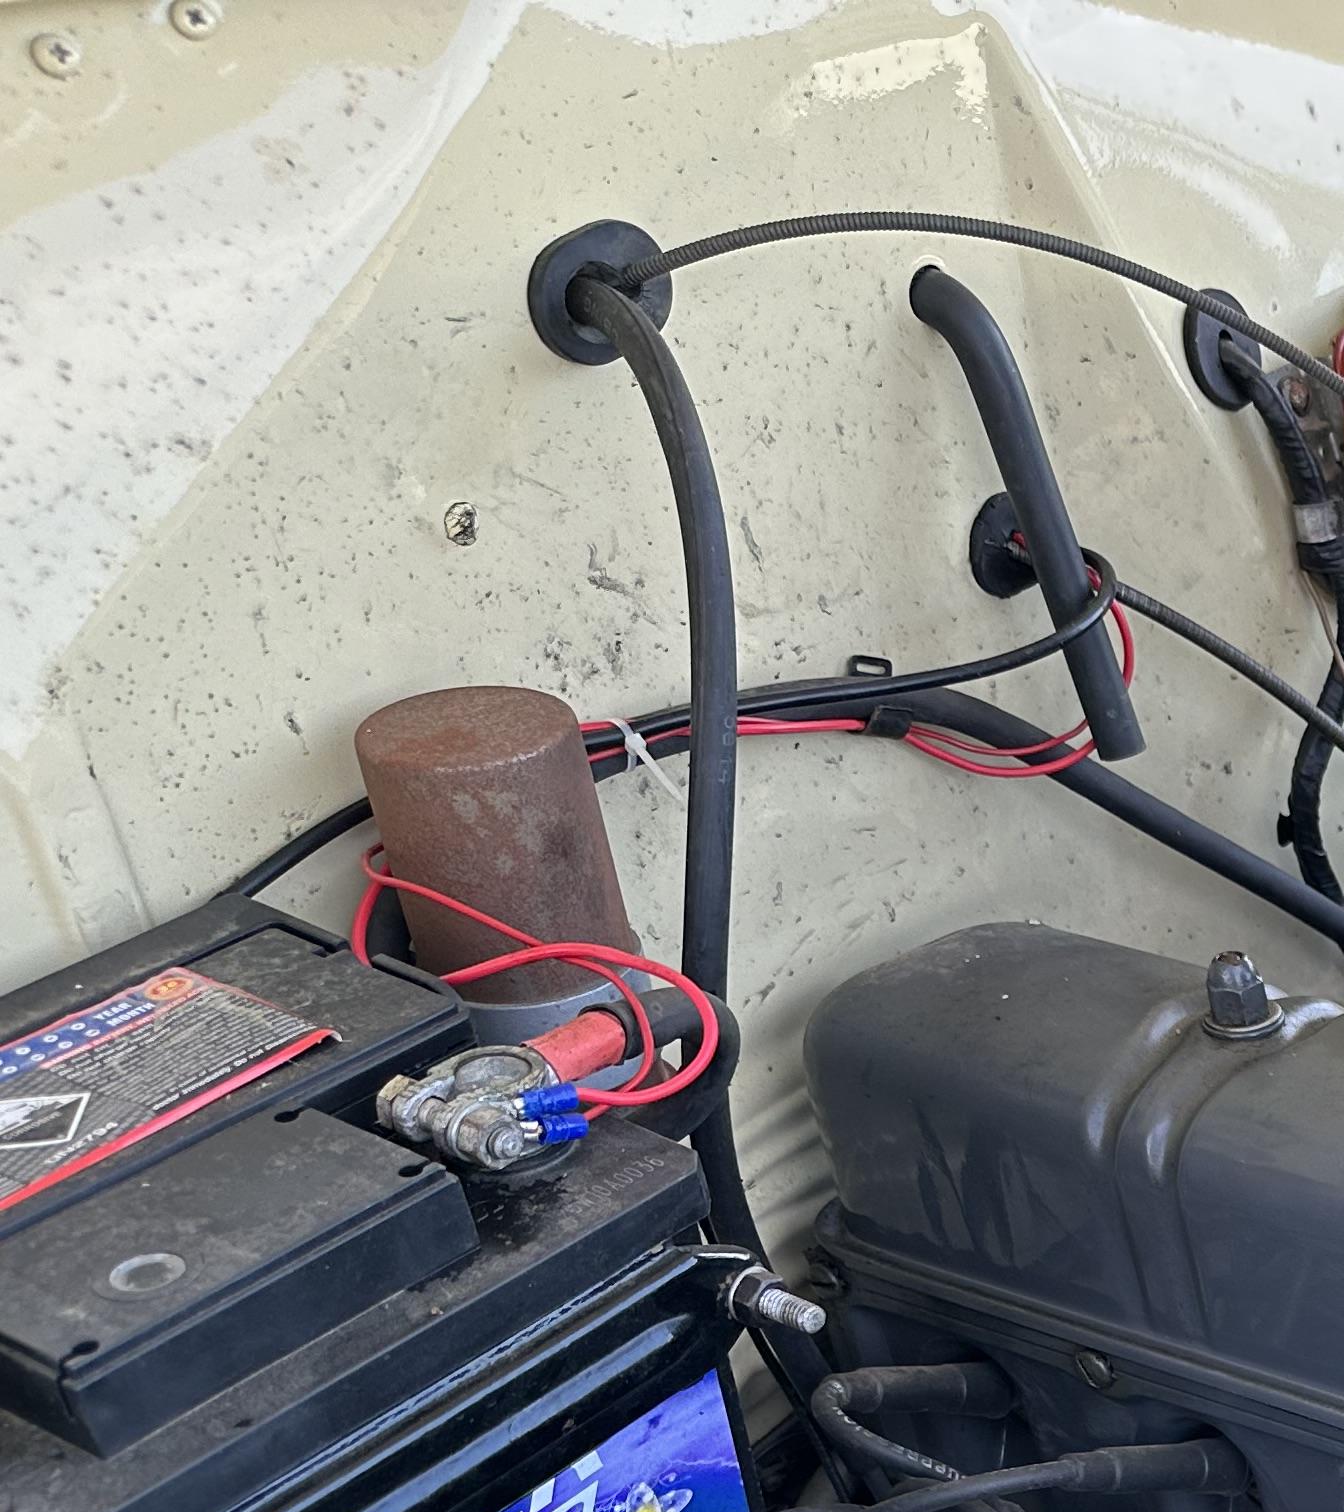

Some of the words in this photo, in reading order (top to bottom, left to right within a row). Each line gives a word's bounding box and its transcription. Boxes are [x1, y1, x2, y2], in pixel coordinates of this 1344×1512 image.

[92, 1002, 133, 1020] YEAR
[105, 1002, 156, 1026] MONTH
[45, 1121, 118, 1165] UN2794
